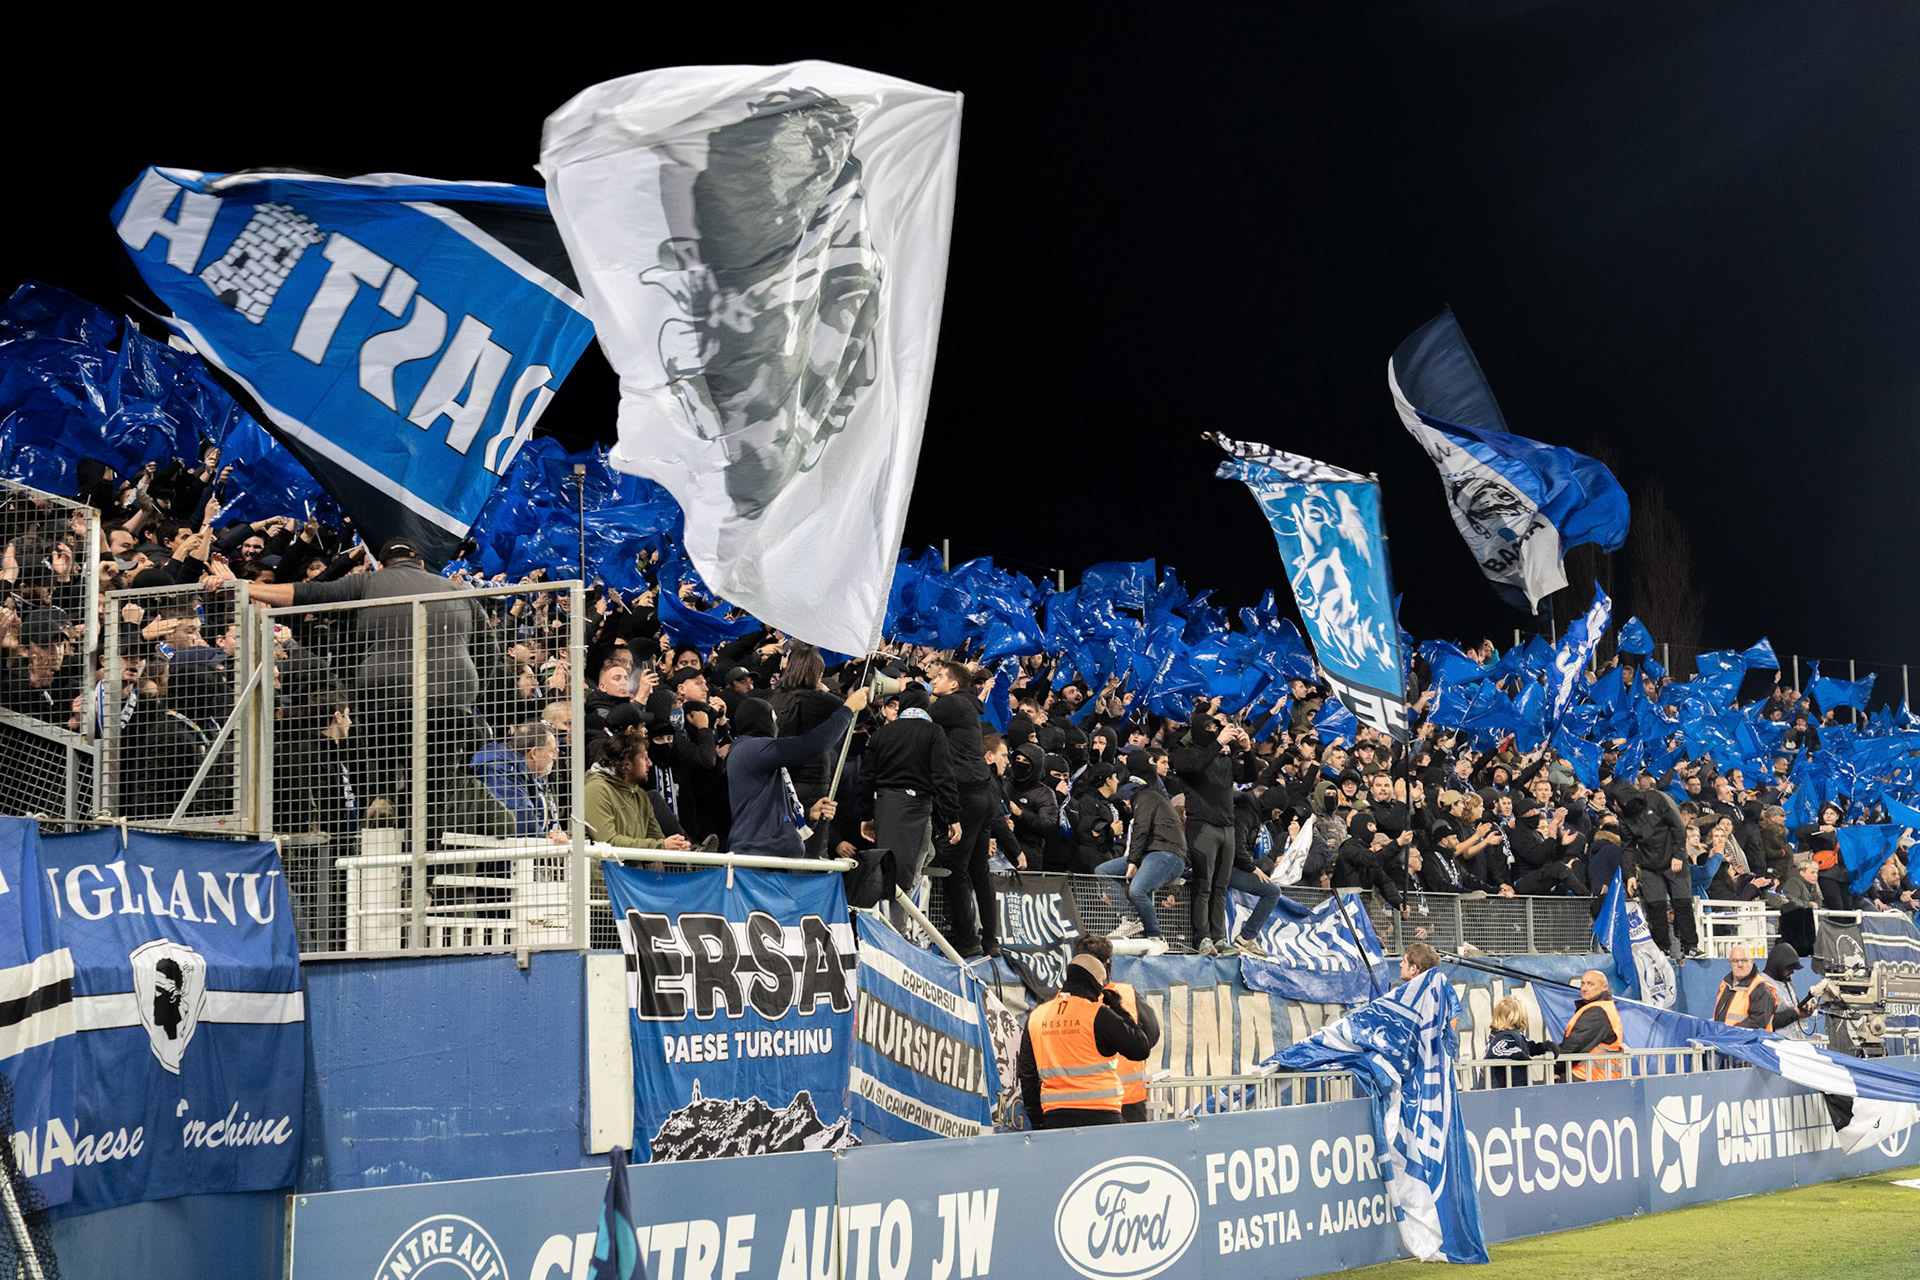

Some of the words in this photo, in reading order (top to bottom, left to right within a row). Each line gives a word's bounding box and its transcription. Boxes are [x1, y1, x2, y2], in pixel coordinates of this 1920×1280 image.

[625, 908, 853, 1022] ERSA
[1041, 1019, 1081, 1029] HESTIA
[1057, 1000, 1068, 1015] 17
[663, 1034, 729, 1064] PAESE
[734, 1026, 834, 1060] TURCHINU
[1716, 1099, 1772, 1167] CASH
[1206, 1144, 1301, 1205] FORD
[1309, 1133, 1384, 1189] COR
[777, 1198, 913, 1280] AUTO
[931, 1187, 1000, 1280] JW
[1088, 1178, 1172, 1259] Ford
[1218, 1209, 1302, 1255] BASTIA
